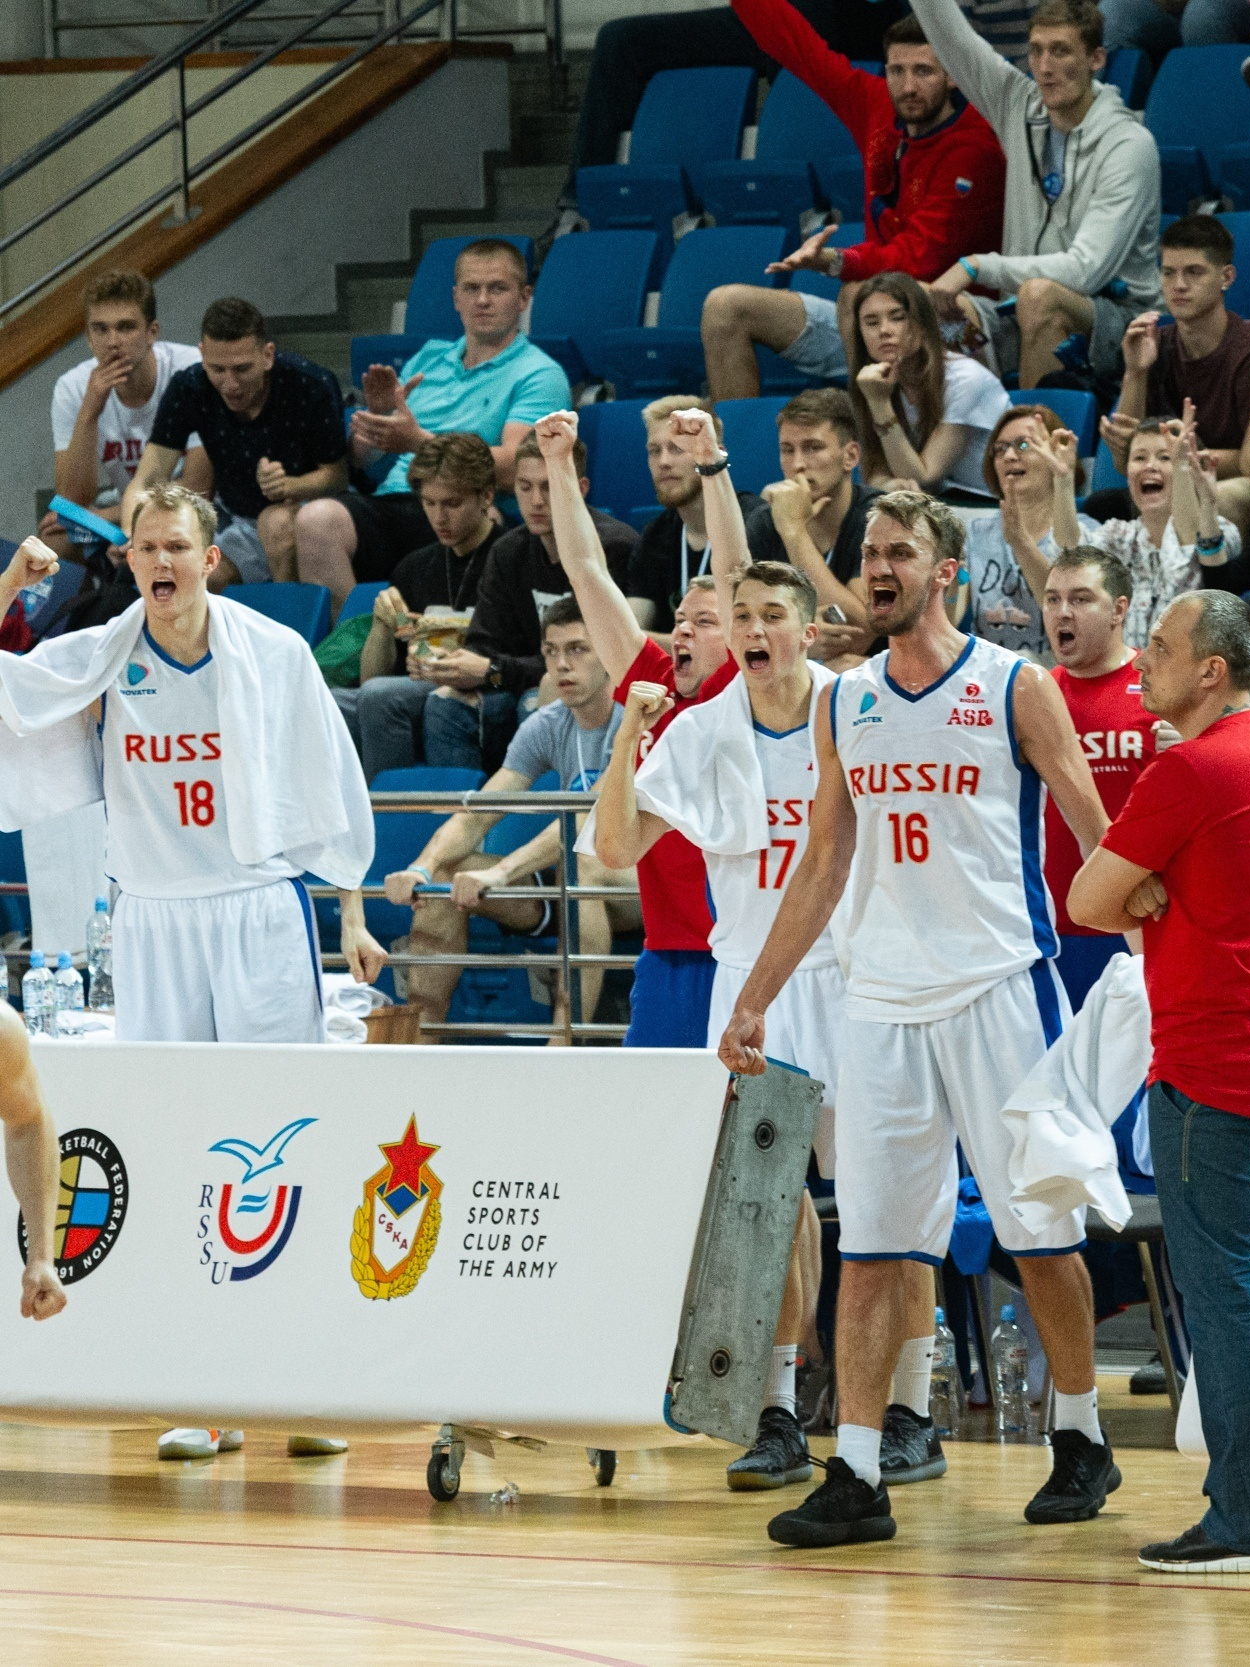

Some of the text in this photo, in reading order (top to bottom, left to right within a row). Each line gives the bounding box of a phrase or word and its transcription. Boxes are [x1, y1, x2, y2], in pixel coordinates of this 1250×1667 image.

[124, 732, 222, 763] RUSS
[1076, 730, 1143, 760] SIA
[849, 763, 981, 798] RUSSIA
[173, 779, 215, 827] 18
[888, 812, 930, 864] 16
[758, 839, 797, 889] 17
[472, 1180, 560, 1200] CENTRAL
[83, 1163, 124, 1269] FEDERATION
[378, 1213, 408, 1250] CSKA
[467, 1206, 540, 1226] SPORTS
[463, 1233, 547, 1252] CLUB OF
[459, 1259, 558, 1279] THE ARMY
